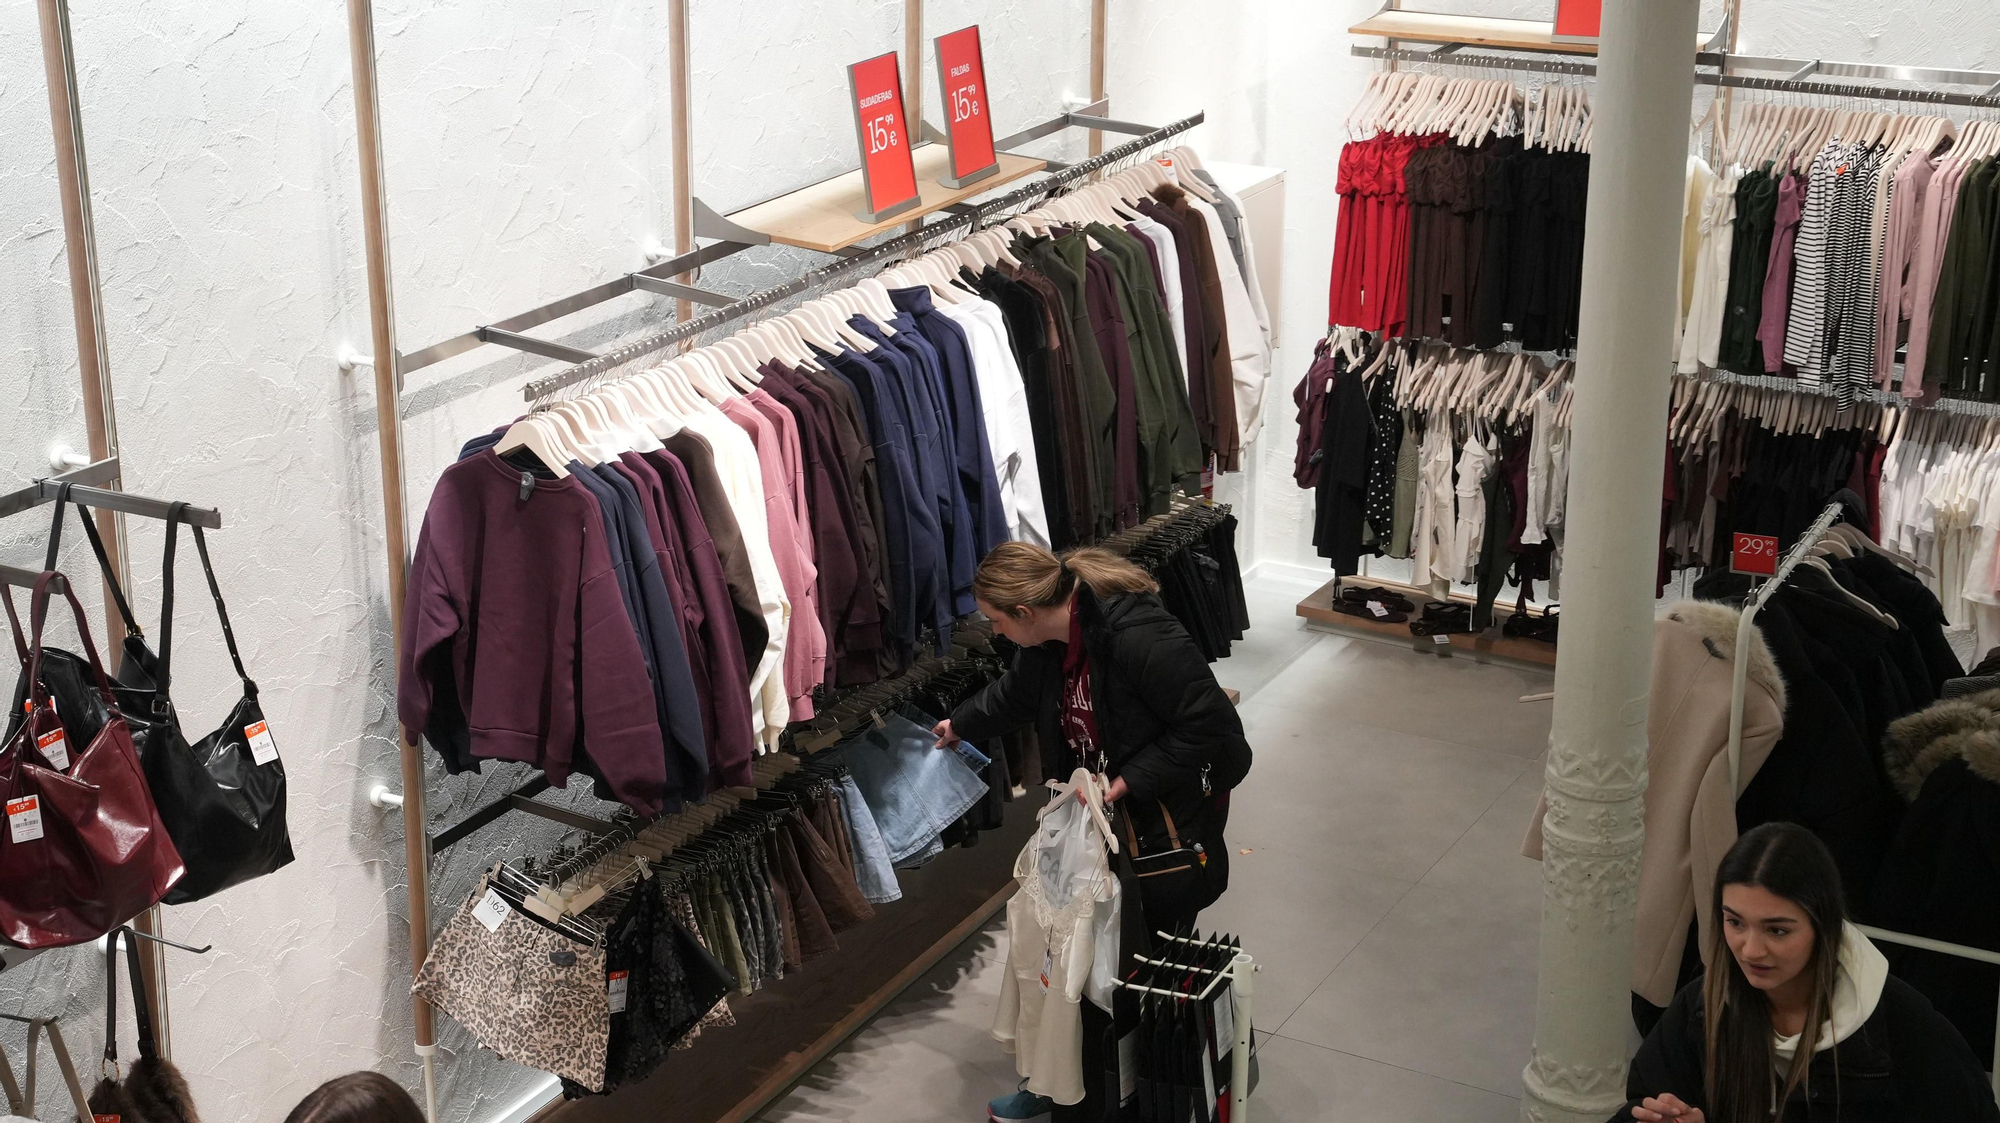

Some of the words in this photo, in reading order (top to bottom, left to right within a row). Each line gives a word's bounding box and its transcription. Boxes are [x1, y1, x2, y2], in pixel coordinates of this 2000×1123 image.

[951, 63, 969, 77] FALDAS
[860, 90, 892, 109] SUDADERAS
[486, 894, 506, 916] D62
